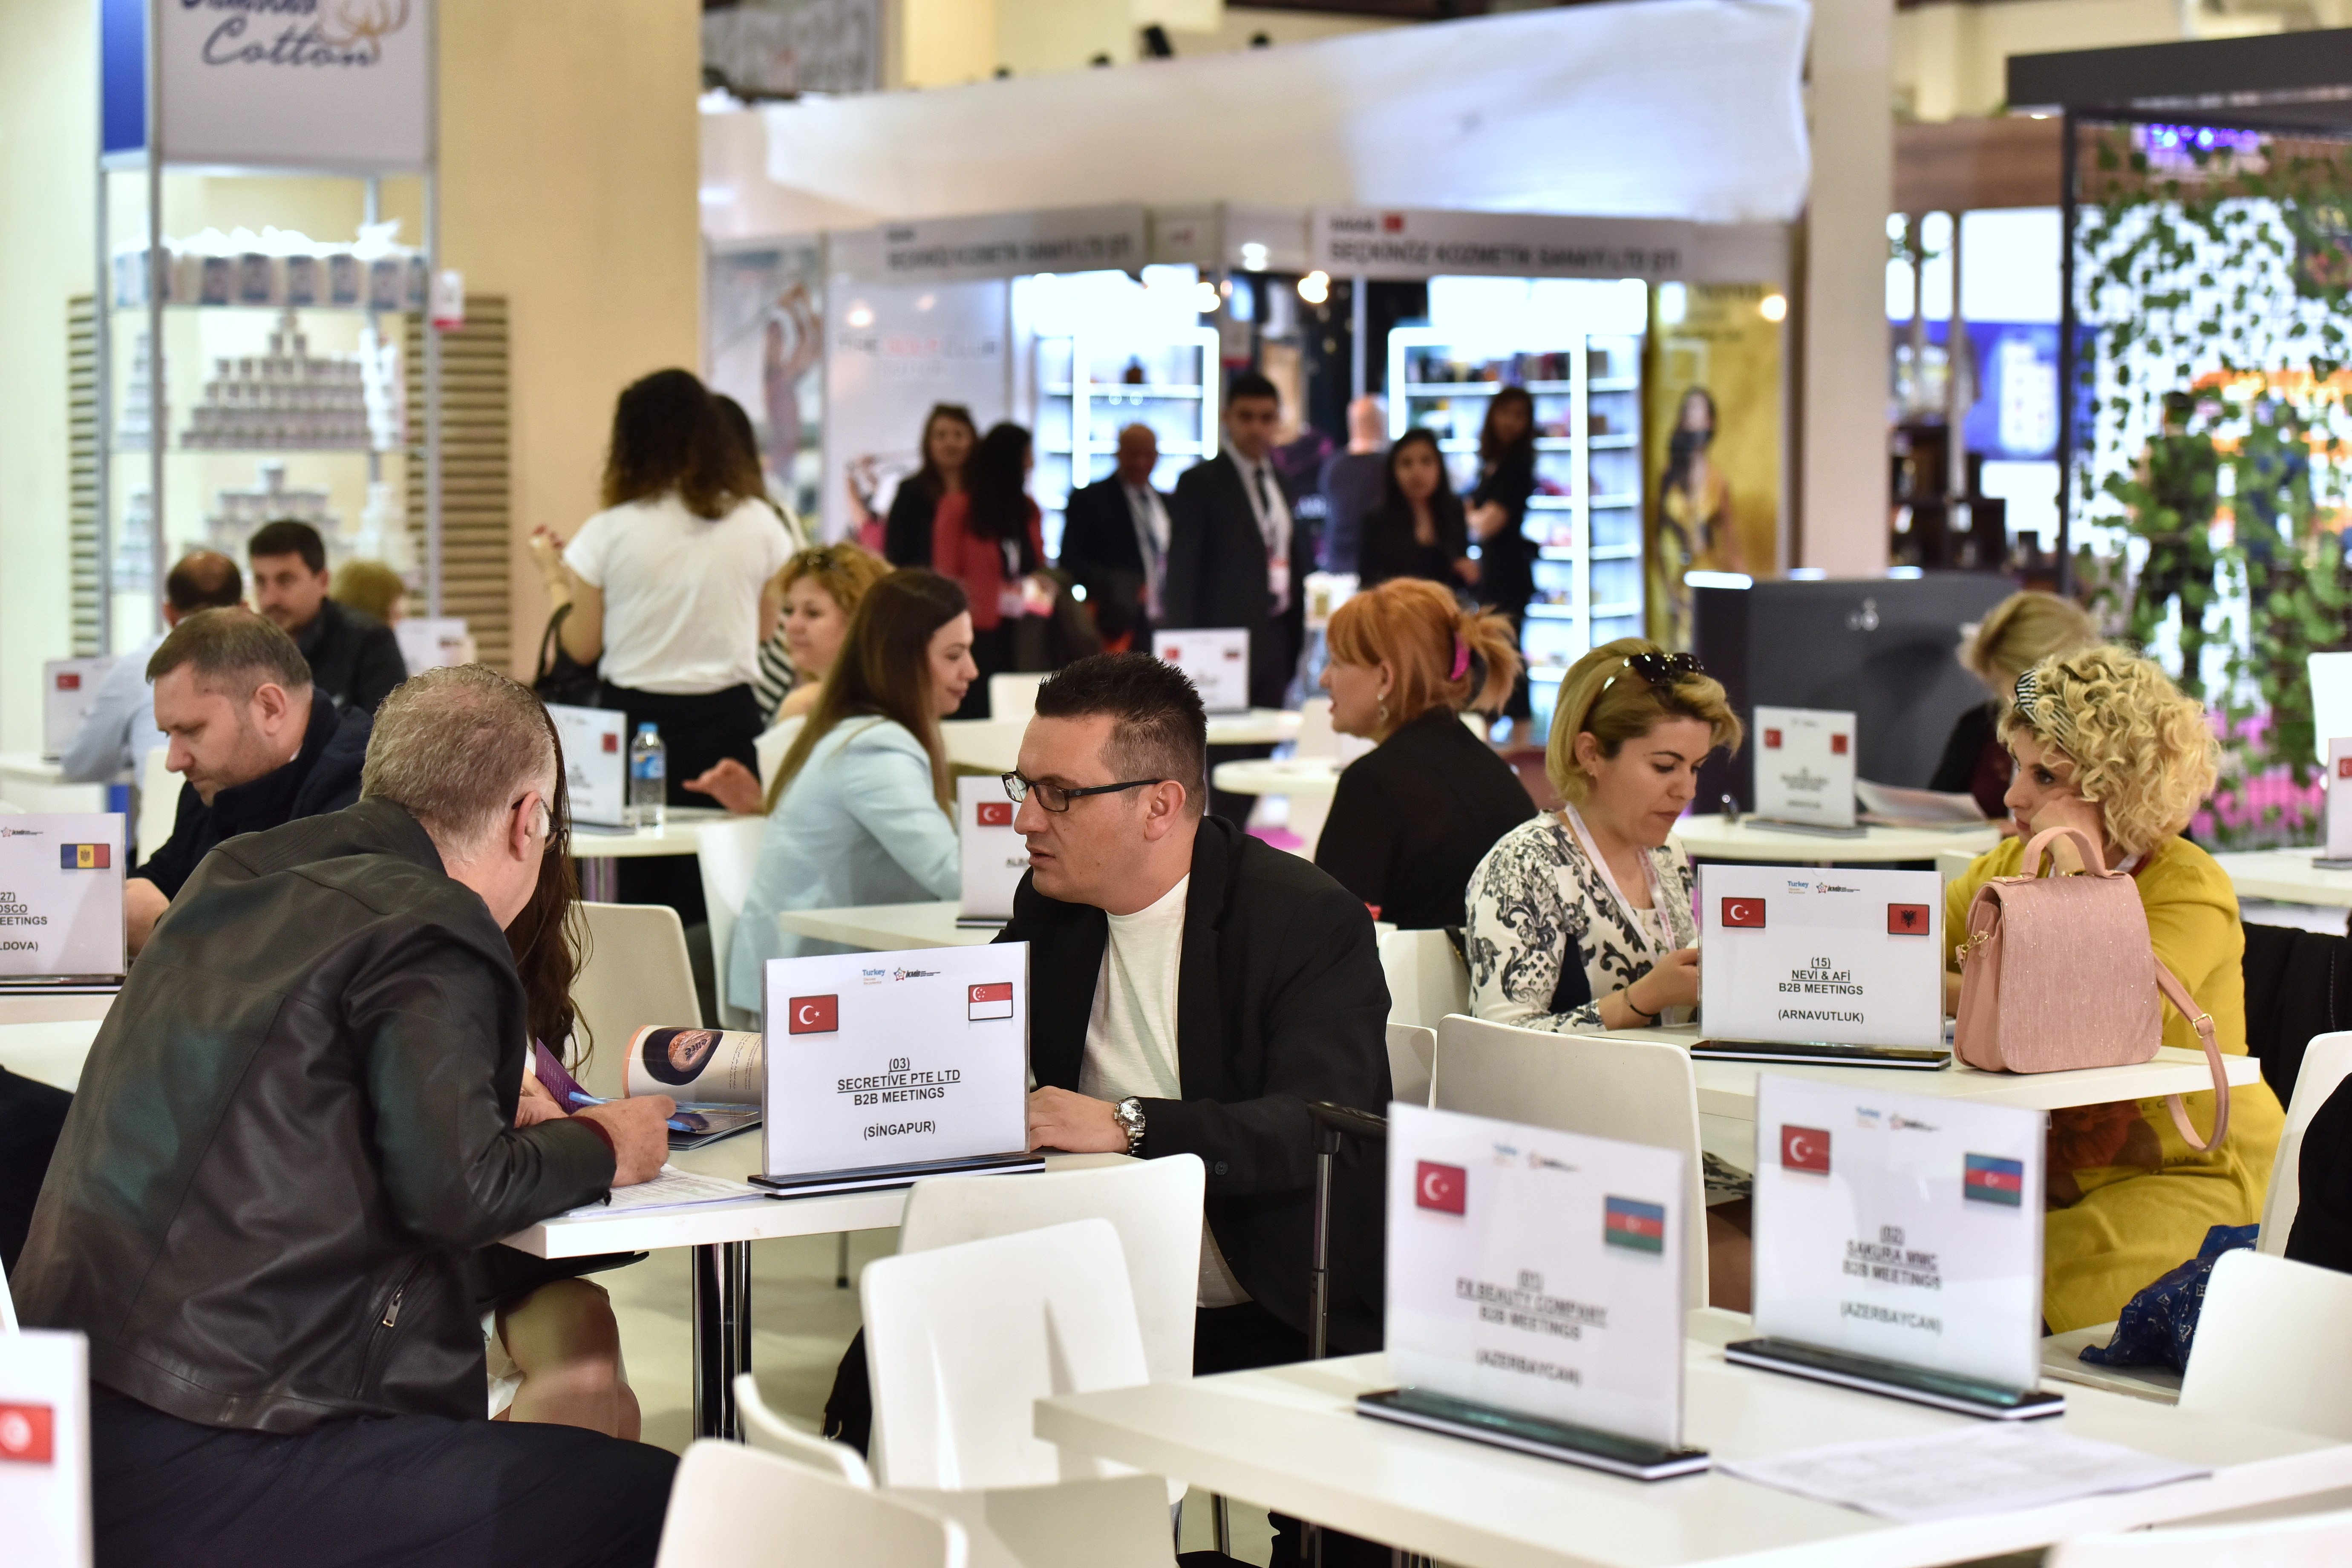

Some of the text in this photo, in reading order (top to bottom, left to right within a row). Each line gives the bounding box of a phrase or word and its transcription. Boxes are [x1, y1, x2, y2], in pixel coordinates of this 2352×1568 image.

[200, 15, 380, 66] Cotton
[1811, 957, 1831, 969] (15)
[1792, 968, 1850, 981] NEVİ & AFİ
[1779, 983, 1863, 995] B2B MEETINGS
[1778, 1009, 1864, 1024] (ARNAVUTLUK)
[685, 1039, 707, 1055] elite
[889, 1057, 911, 1072] (03)
[837, 1069, 960, 1092] SECRETİVE PTE LTD
[854, 1087, 945, 1106] B2B MEETINGS
[864, 1120, 936, 1141] (SİNGAPUR)
[1843, 1259, 1942, 1291] B2B MEETINGS
[1479, 1306, 1582, 1341] B2B MEETINGS
[1840, 1301, 1943, 1335] (AZERBAYCAN)
[1476, 1349, 1583, 1387] (AZERBAYCAN)
